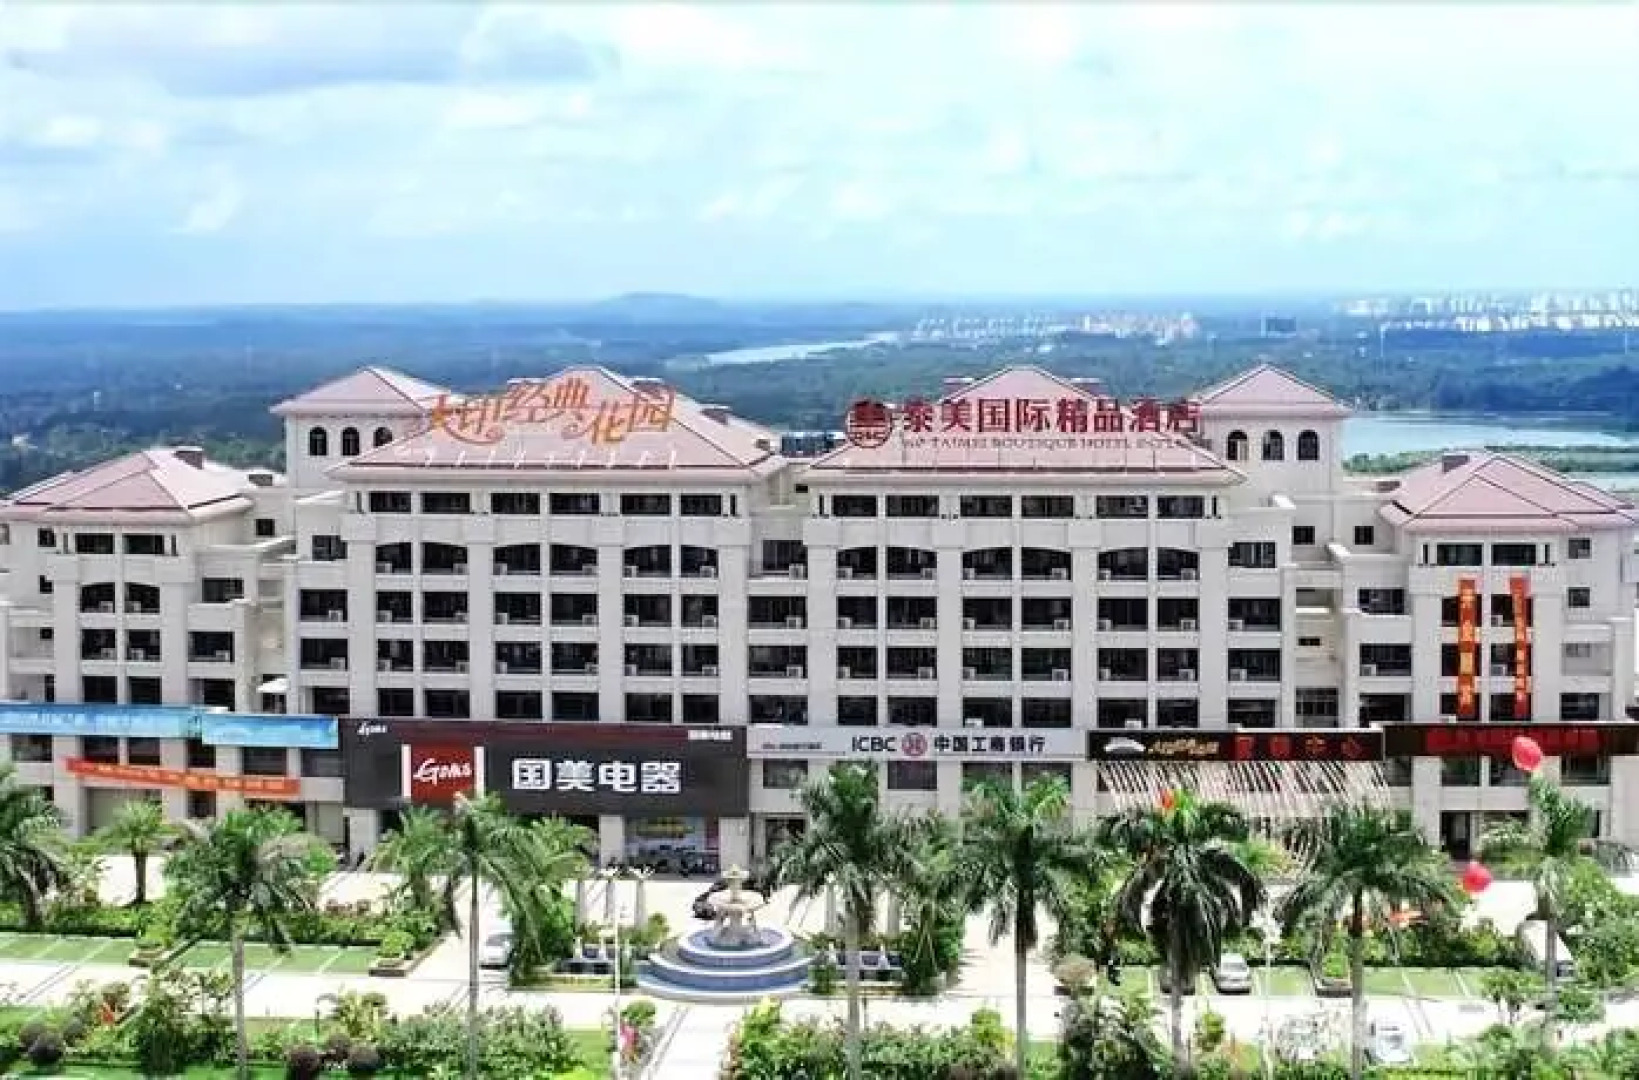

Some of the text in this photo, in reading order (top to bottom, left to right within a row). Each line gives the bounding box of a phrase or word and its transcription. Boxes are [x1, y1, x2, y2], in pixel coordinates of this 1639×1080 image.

[902, 398, 1202, 433] 泰美国际精品酒店
[992, 438, 1076, 450] BOUTIQUE
[851, 735, 898, 752] ICBC
[934, 735, 1046, 752] 中国工商银行
[510, 759, 682, 793] 国美电器
